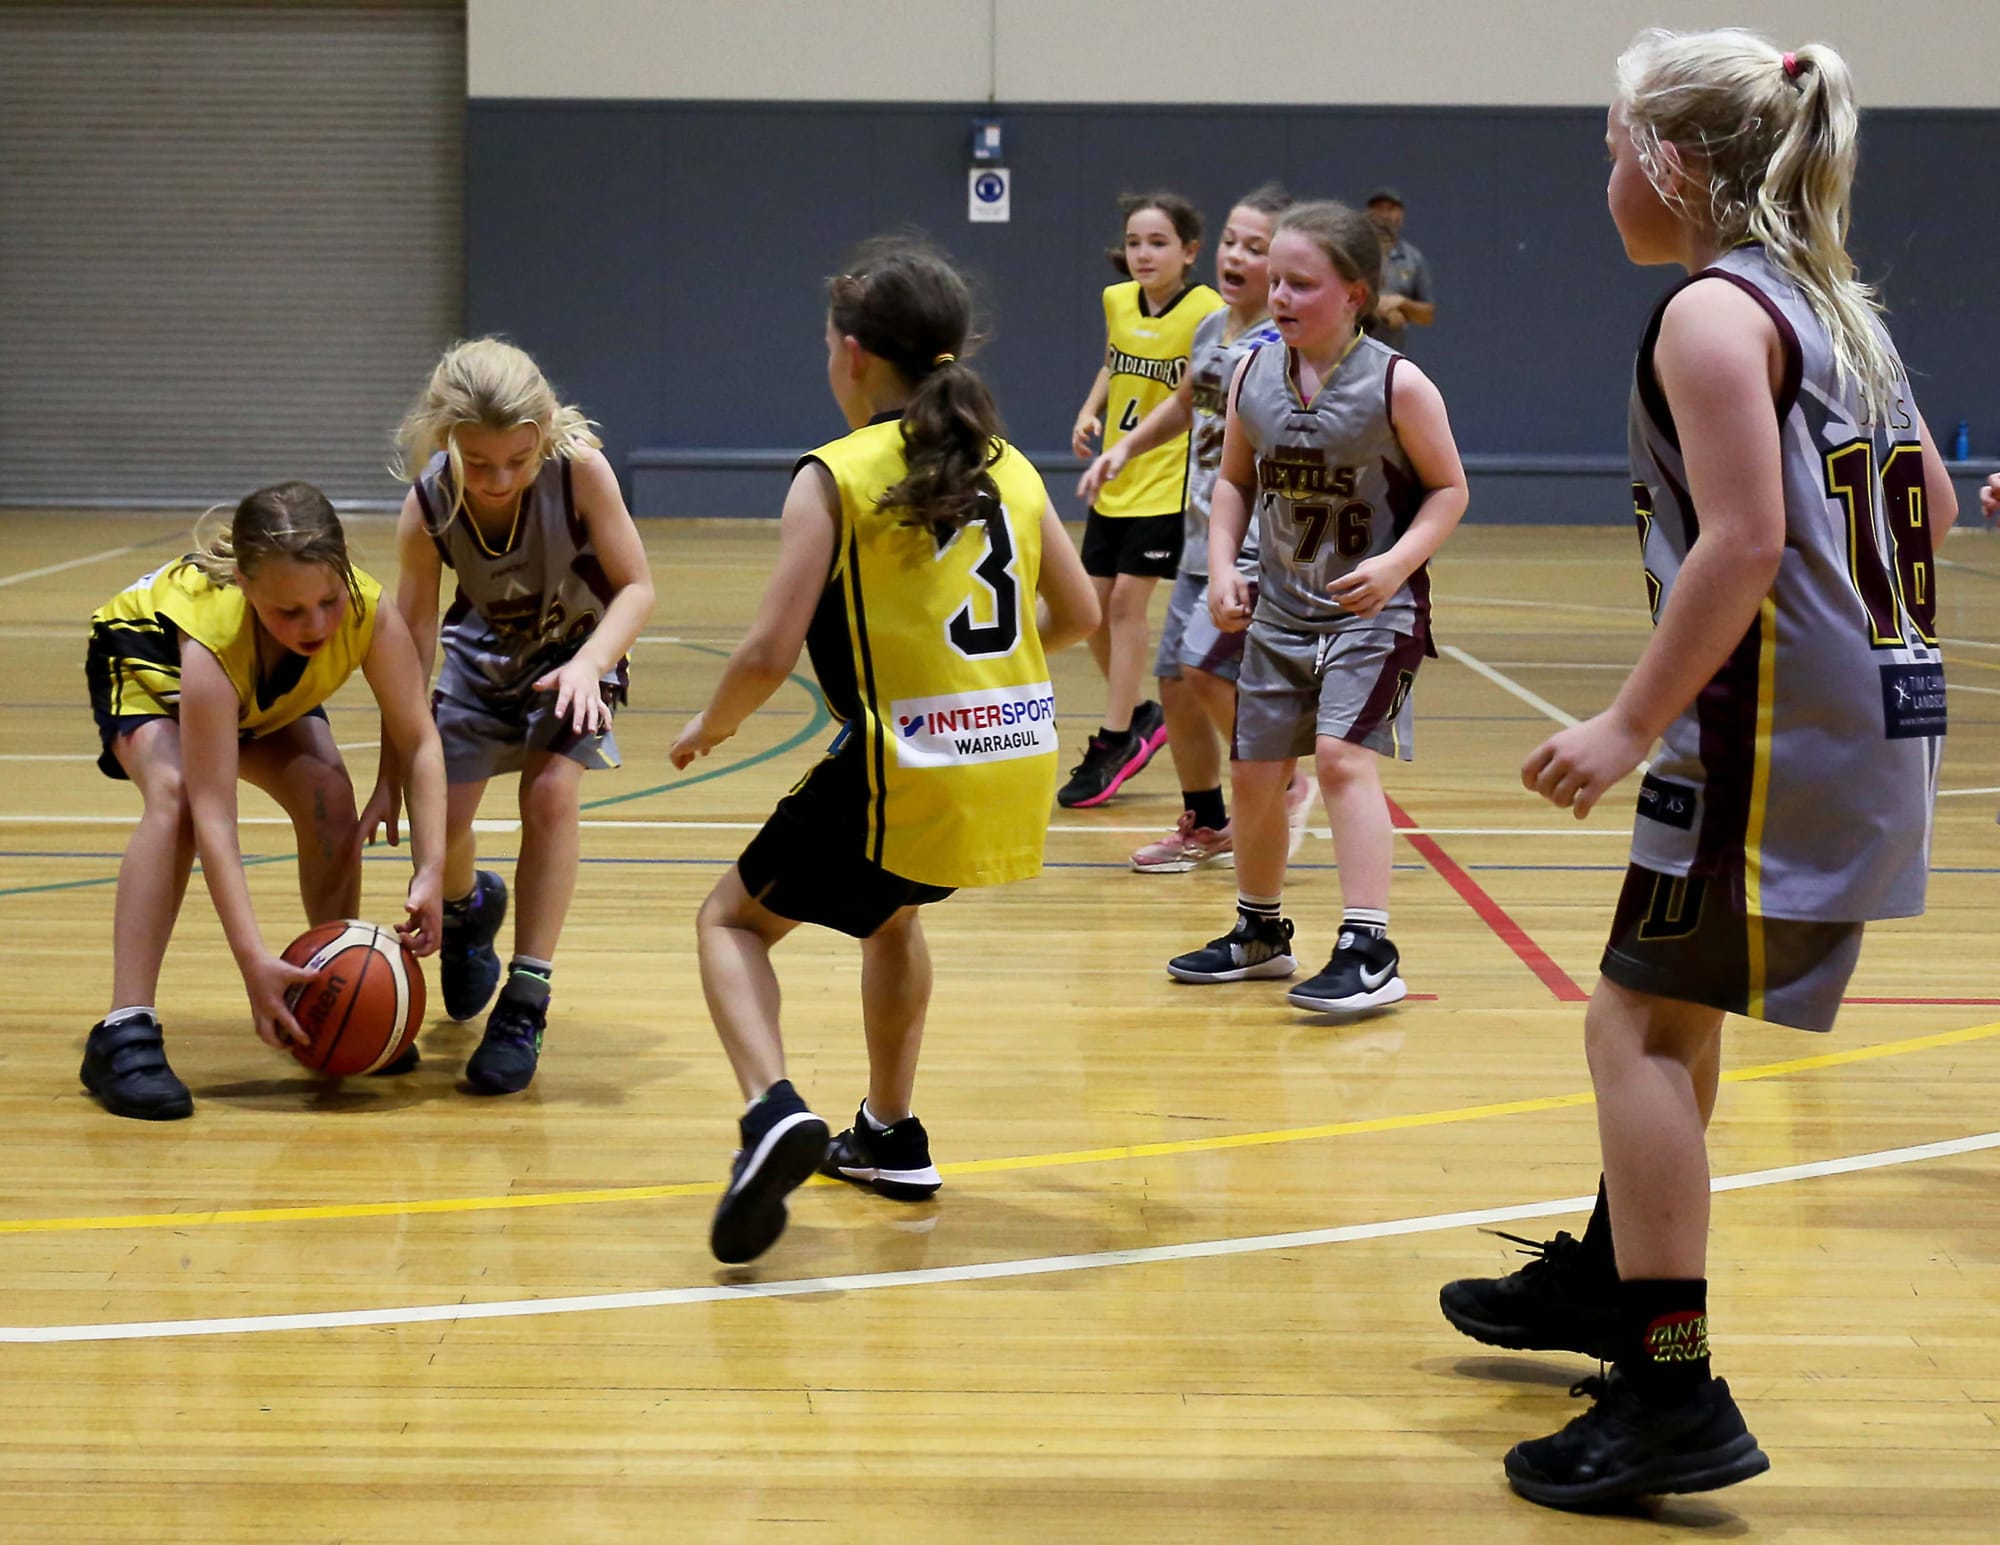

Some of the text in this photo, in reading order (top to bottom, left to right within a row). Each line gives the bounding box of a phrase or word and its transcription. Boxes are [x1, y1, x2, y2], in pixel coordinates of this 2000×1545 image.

[1291, 499, 1375, 563] 76
[934, 488, 1022, 661] 3
[927, 696, 1056, 736] INTERSPORT
[955, 730, 1040, 755] WARRAGUL
